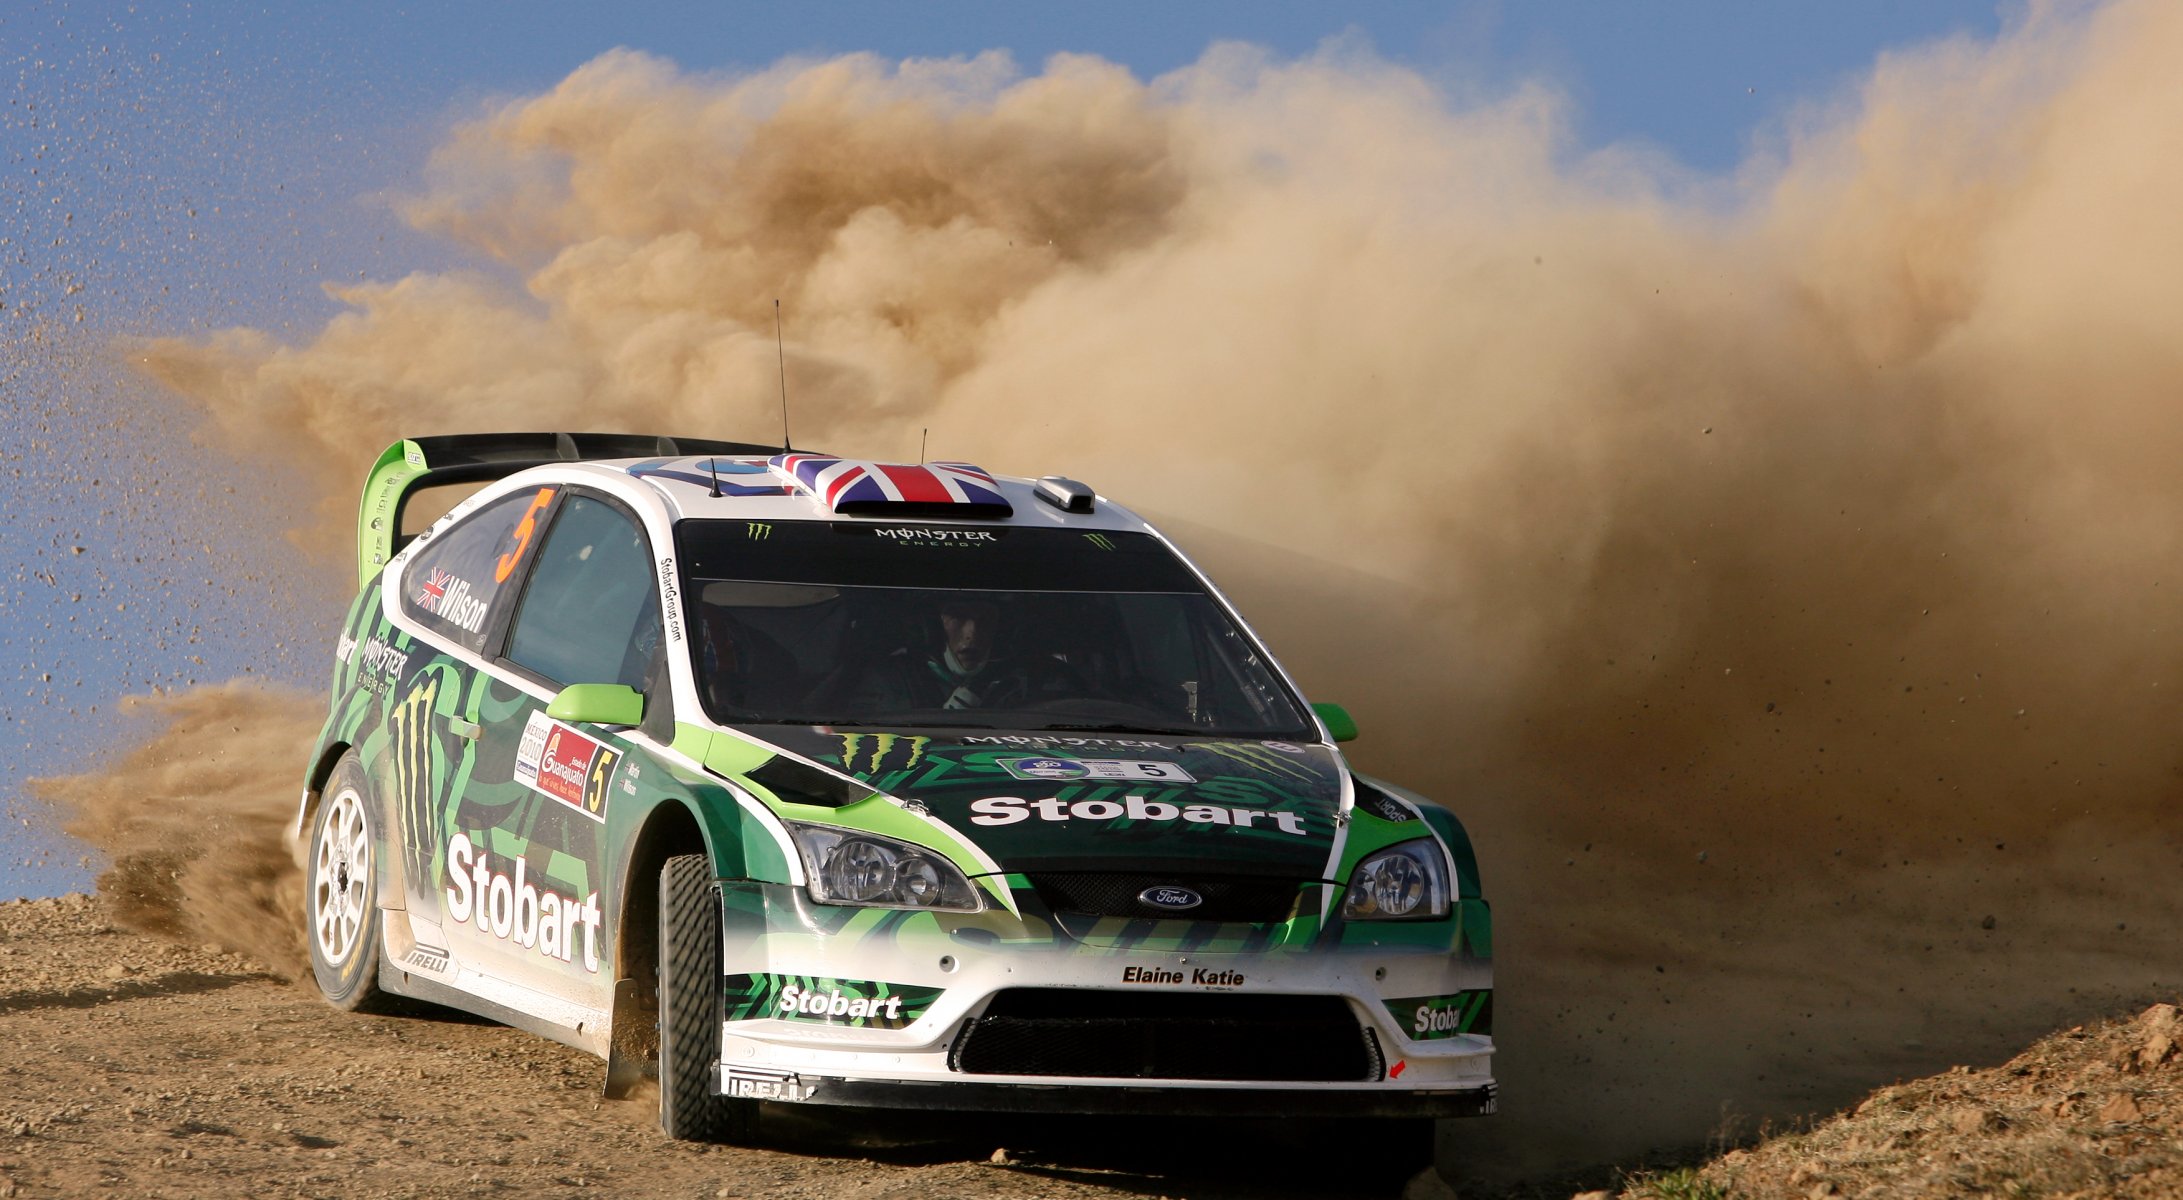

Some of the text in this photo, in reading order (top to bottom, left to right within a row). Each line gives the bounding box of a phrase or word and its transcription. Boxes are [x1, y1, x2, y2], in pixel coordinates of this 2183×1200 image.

[495, 488, 555, 583] 5
[875, 528, 997, 542] MONSTER
[437, 575, 488, 634] Wilson
[661, 557, 682, 642] StobartGroup.com
[362, 636, 409, 681] MONSTER
[357, 672, 393, 695] ENERGY
[519, 737, 543, 761] 2010
[541, 749, 584, 787] Guanajuato
[589, 750, 613, 812] 5
[1137, 763, 1167, 777] 5
[970, 795, 1307, 836] Stobart
[447, 832, 601, 974] Stobart
[1156, 889, 1188, 904] Ford
[1122, 966, 1245, 987] Elaine Katie
[780, 985, 902, 1020] Stobart
